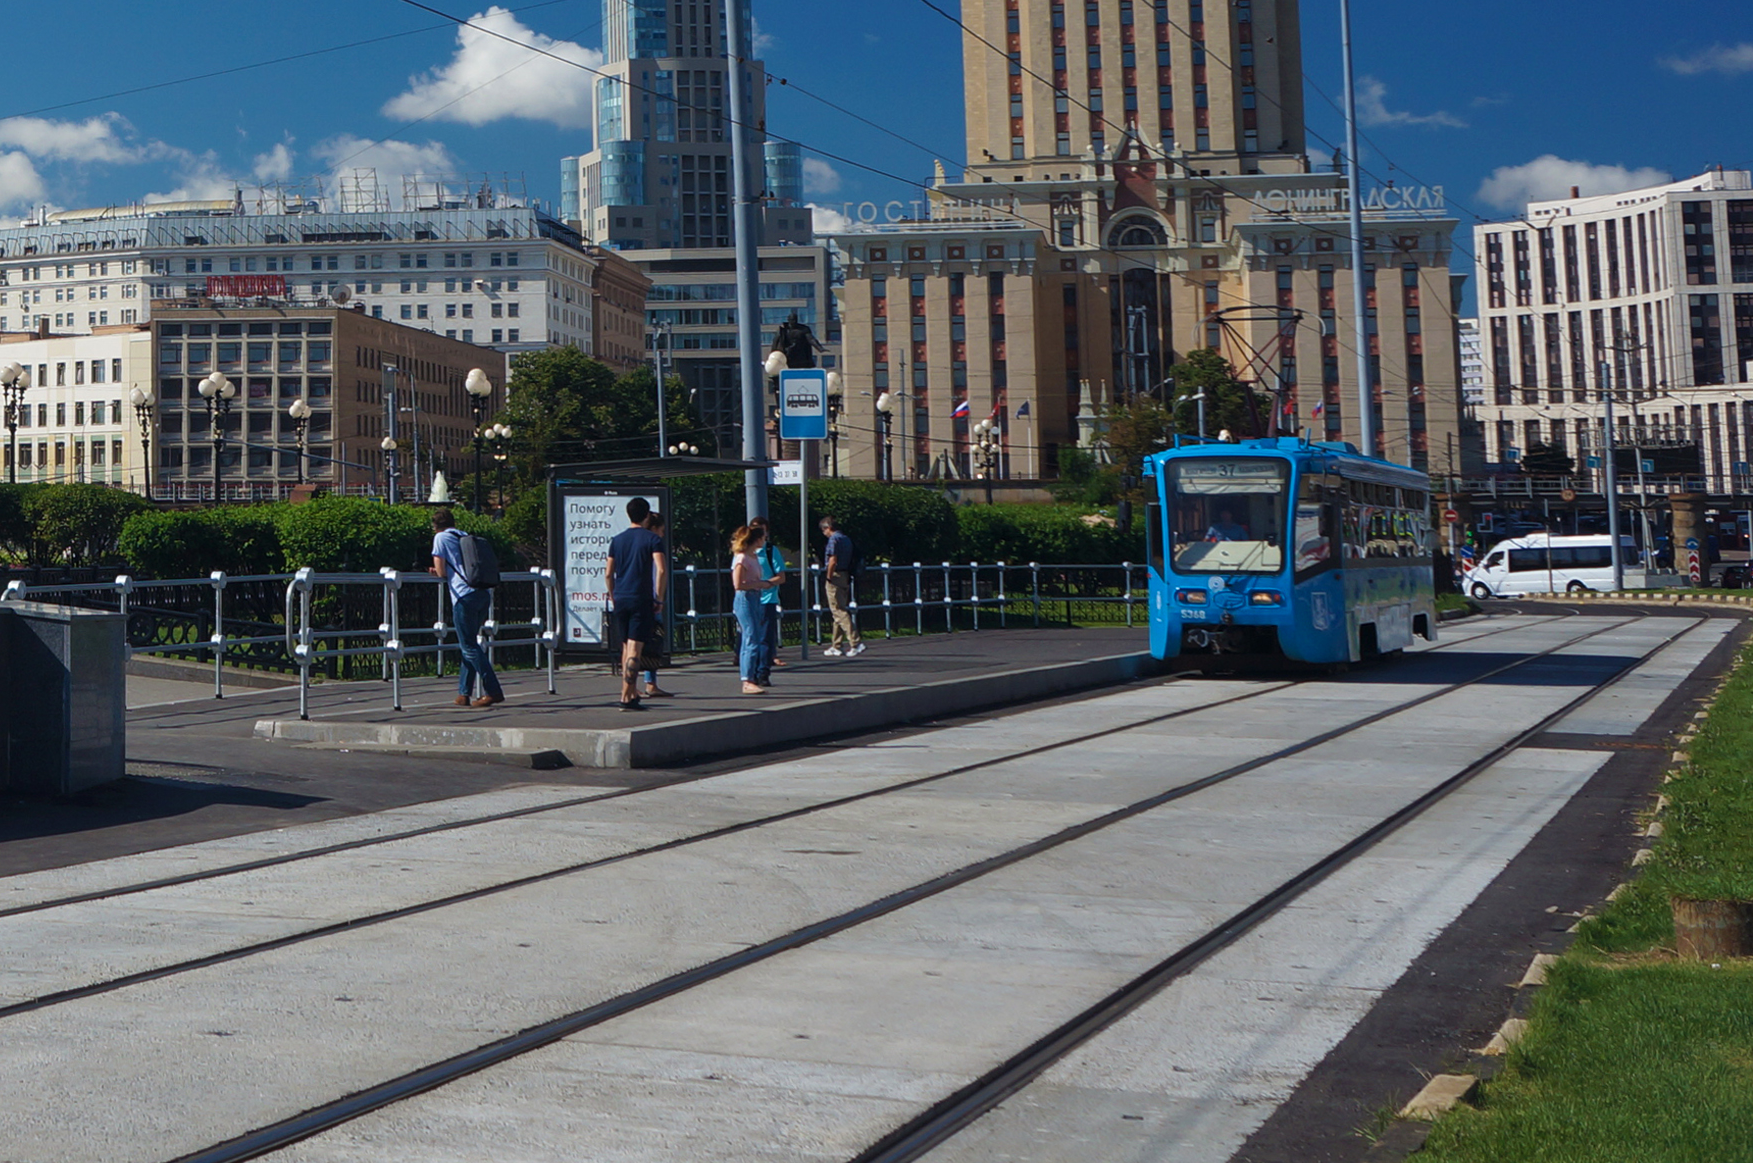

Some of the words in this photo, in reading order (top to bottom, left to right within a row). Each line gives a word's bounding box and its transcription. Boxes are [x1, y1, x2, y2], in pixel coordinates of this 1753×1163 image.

[1218, 464, 1236, 476] 37
[570, 503, 616, 515] Помогу
[570, 521, 612, 532] узнать
[571, 536, 613, 546] истори
[571, 551, 607, 562] перед
[571, 567, 607, 577] покуп
